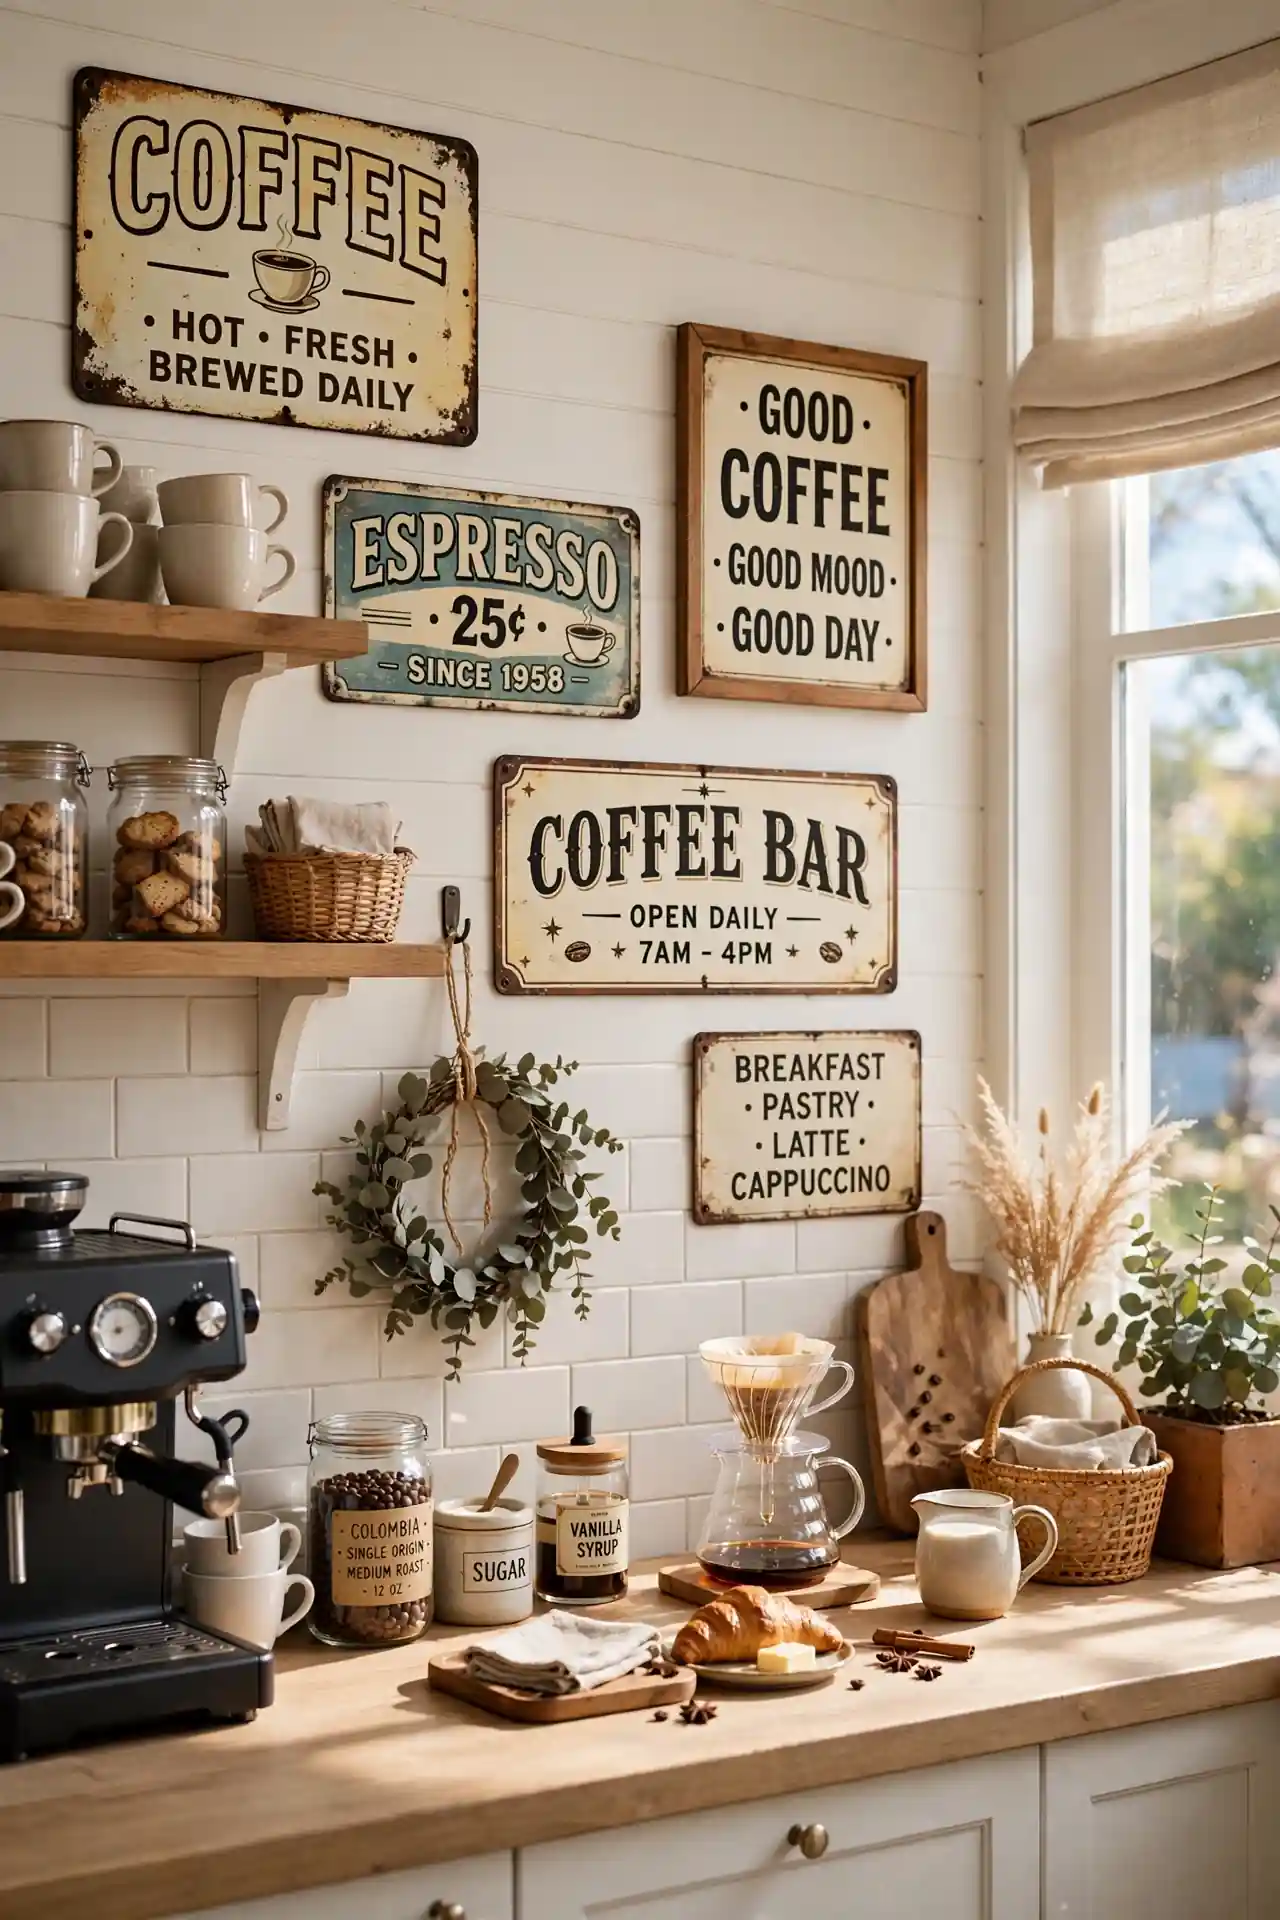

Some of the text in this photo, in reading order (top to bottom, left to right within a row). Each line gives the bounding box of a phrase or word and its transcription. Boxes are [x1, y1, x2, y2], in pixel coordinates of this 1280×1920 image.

[108, 115, 447, 286] COFFEE
[172, 309, 394, 369] HOT FRESH
[149, 349, 414, 412] BREWED DAILY
[758, 384, 854, 445] GOOD
[720, 447, 890, 536] COFFEE
[351, 512, 620, 611] ESPRESSO
[728, 543, 885, 598] GOOD MOOD
[450, 594, 526, 649] 25¢
[732, 606, 880, 662] GOOD DAY
[407, 654, 565, 694] SINCE 1958
[527, 804, 872, 909] COFFEE BAR
[630, 904, 777, 930] OPEN DAILY
[639, 941, 691, 964] 7AM
[721, 941, 773, 965] 4PM
[735, 1053, 885, 1083] BREAKFAST
[763, 1090, 860, 1121] PASTRY
[773, 1129, 850, 1159] LATTE
[731, 1165, 890, 1201] CAPPUCCINO
[350, 1517, 420, 1540] COLOMBIA
[570, 1518, 622, 1538] VANILLA
[346, 1540, 424, 1560] SINGLE ORIGIN
[576, 1538, 619, 1558] SYRUP
[347, 1559, 424, 1579] MEDIUM ROAST
[472, 1557, 526, 1582] SUGAR
[374, 1583, 403, 1596] 12 OZ
